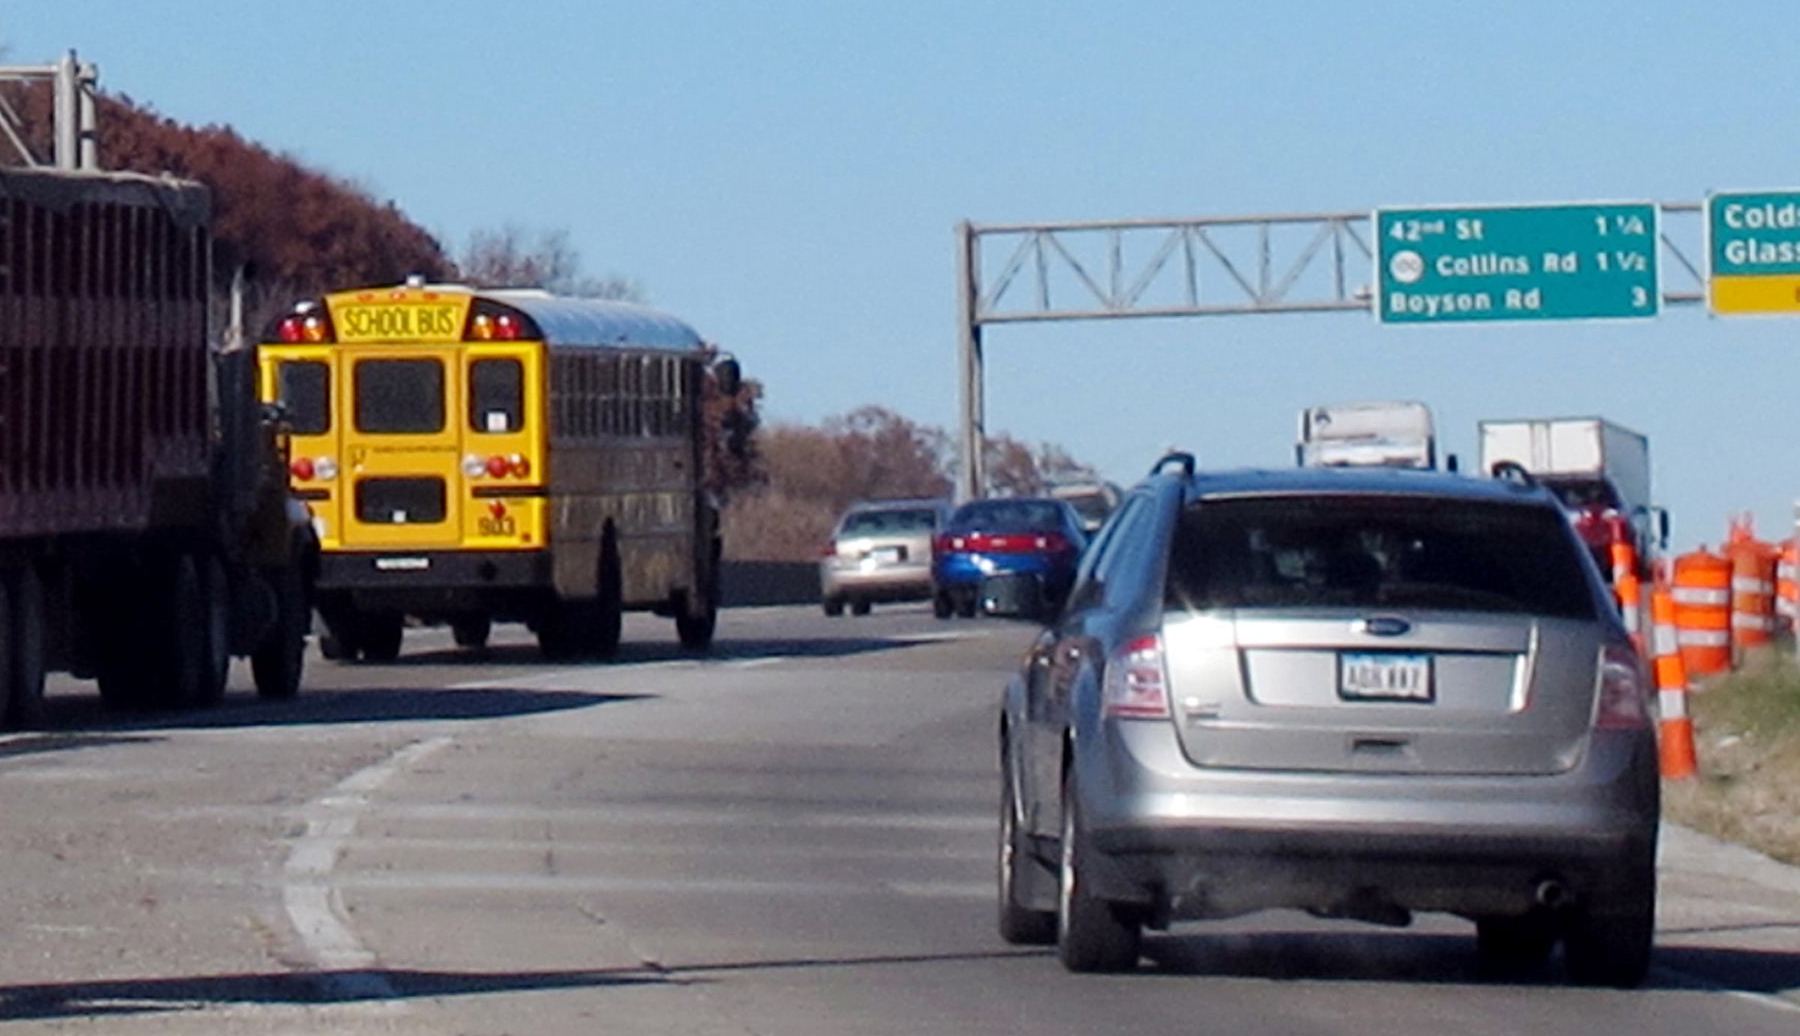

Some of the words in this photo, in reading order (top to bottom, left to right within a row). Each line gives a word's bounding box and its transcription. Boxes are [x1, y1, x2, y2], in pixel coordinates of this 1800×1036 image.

[1725, 203, 1800, 228] Cold
[1390, 219, 1445, 241] 42nd
[1456, 218, 1483, 240] St
[1595, 216, 1607, 236] 1
[1436, 253, 1530, 276] Collins
[1543, 251, 1577, 273] Rd
[1596, 252, 1608, 271] 1
[1390, 291, 1491, 316] Boyson
[1506, 288, 1540, 310] Rd
[1632, 287, 1647, 308] 3
[344, 307, 414, 336] SCHOOL
[417, 307, 453, 335] BUS
